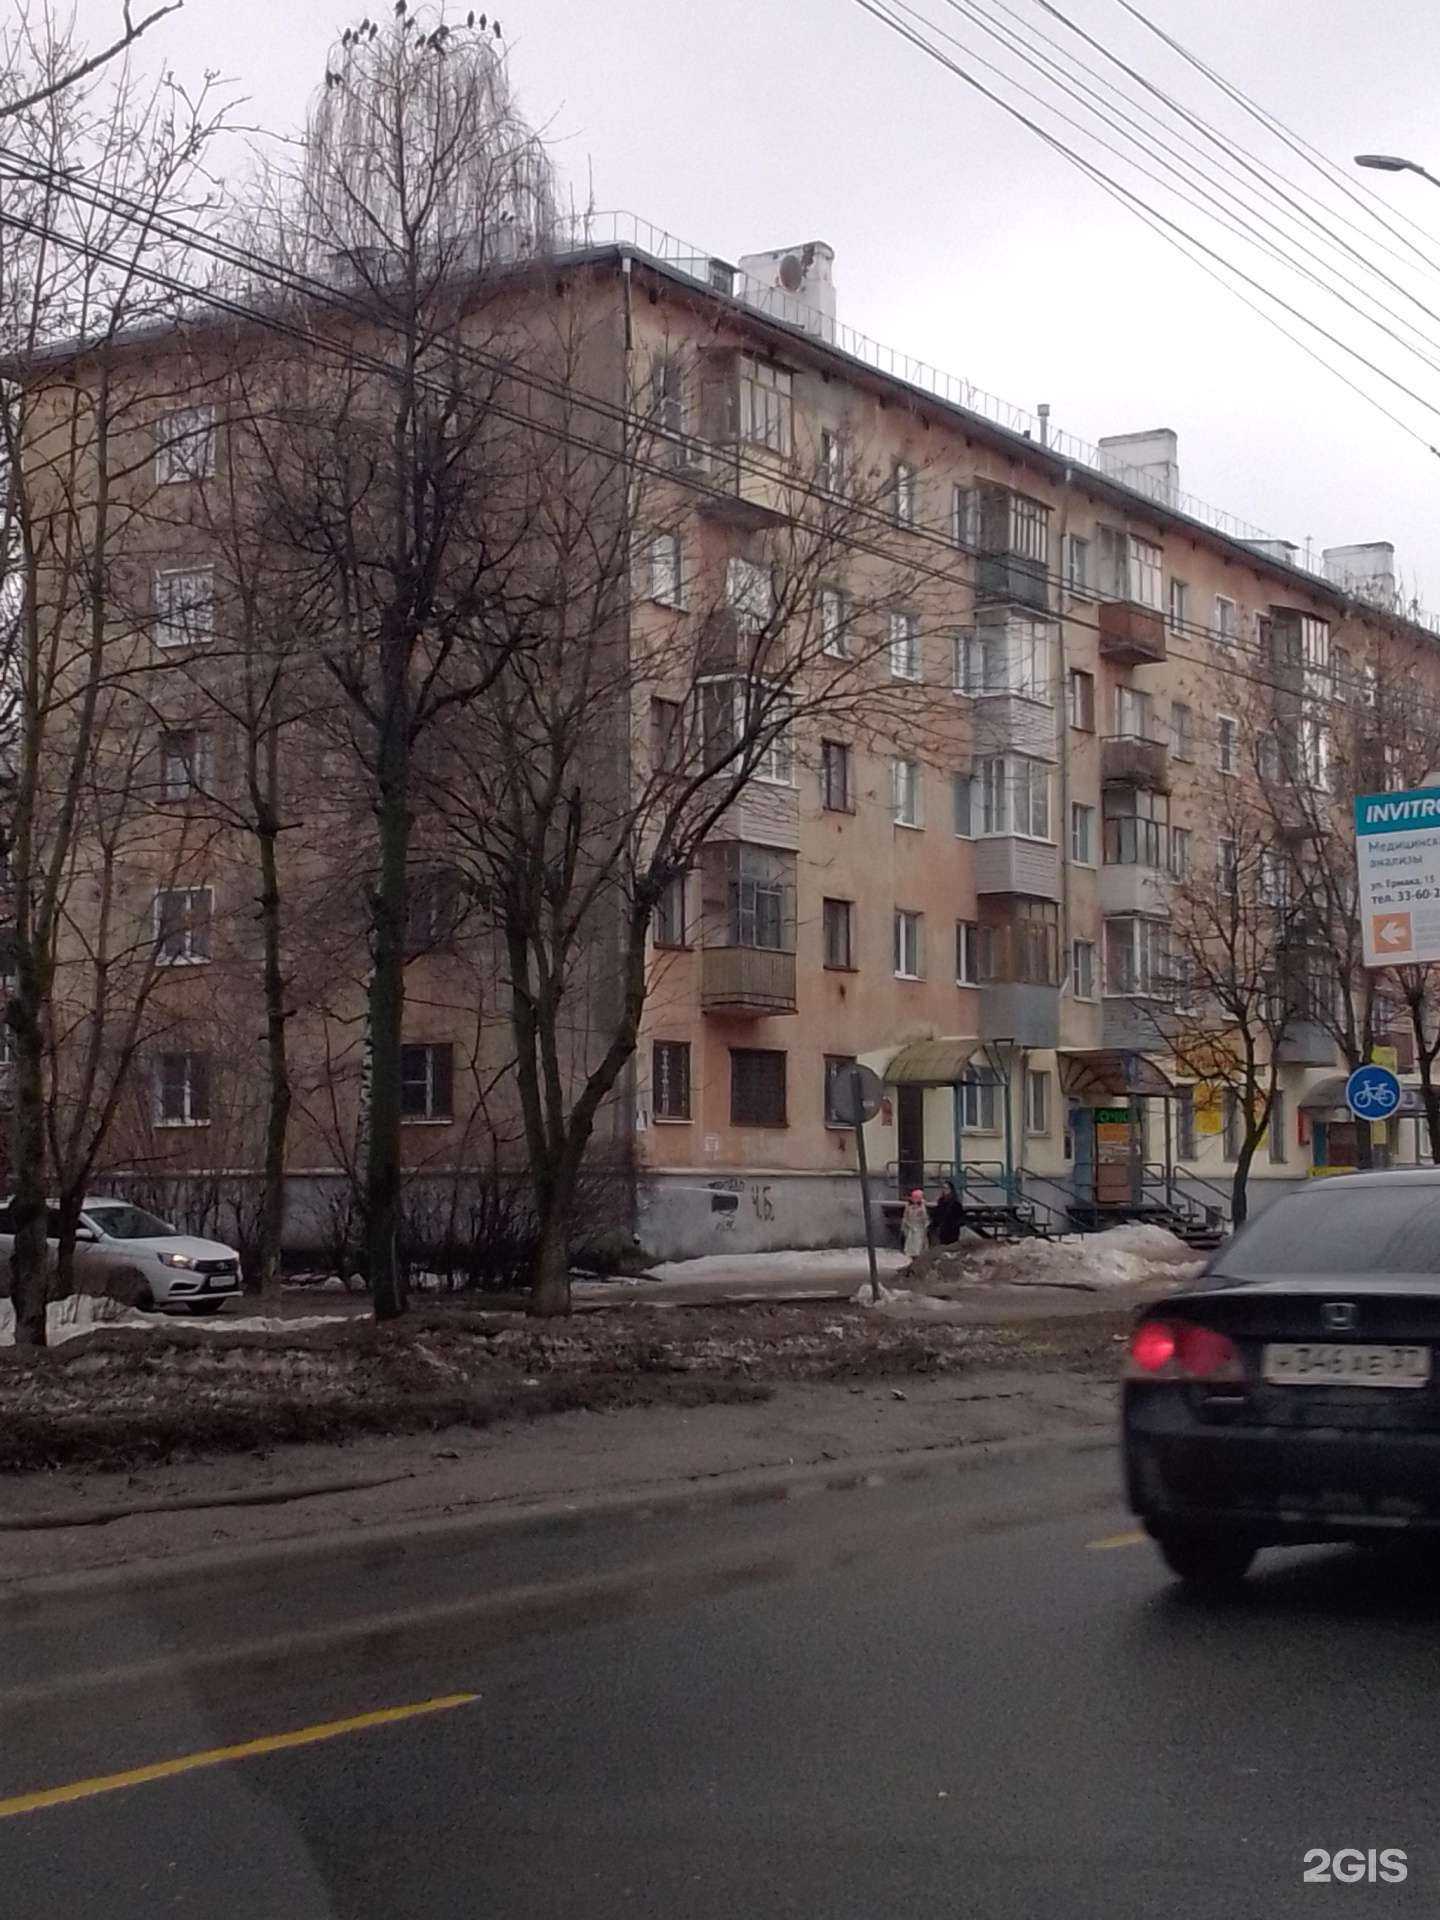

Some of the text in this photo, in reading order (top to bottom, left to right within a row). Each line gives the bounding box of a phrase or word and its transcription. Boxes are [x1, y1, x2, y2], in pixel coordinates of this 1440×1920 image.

[1368, 838, 1440, 852] Медицинск
[1370, 855, 1423, 868] анализы
[1370, 894, 1394, 904] тел.
